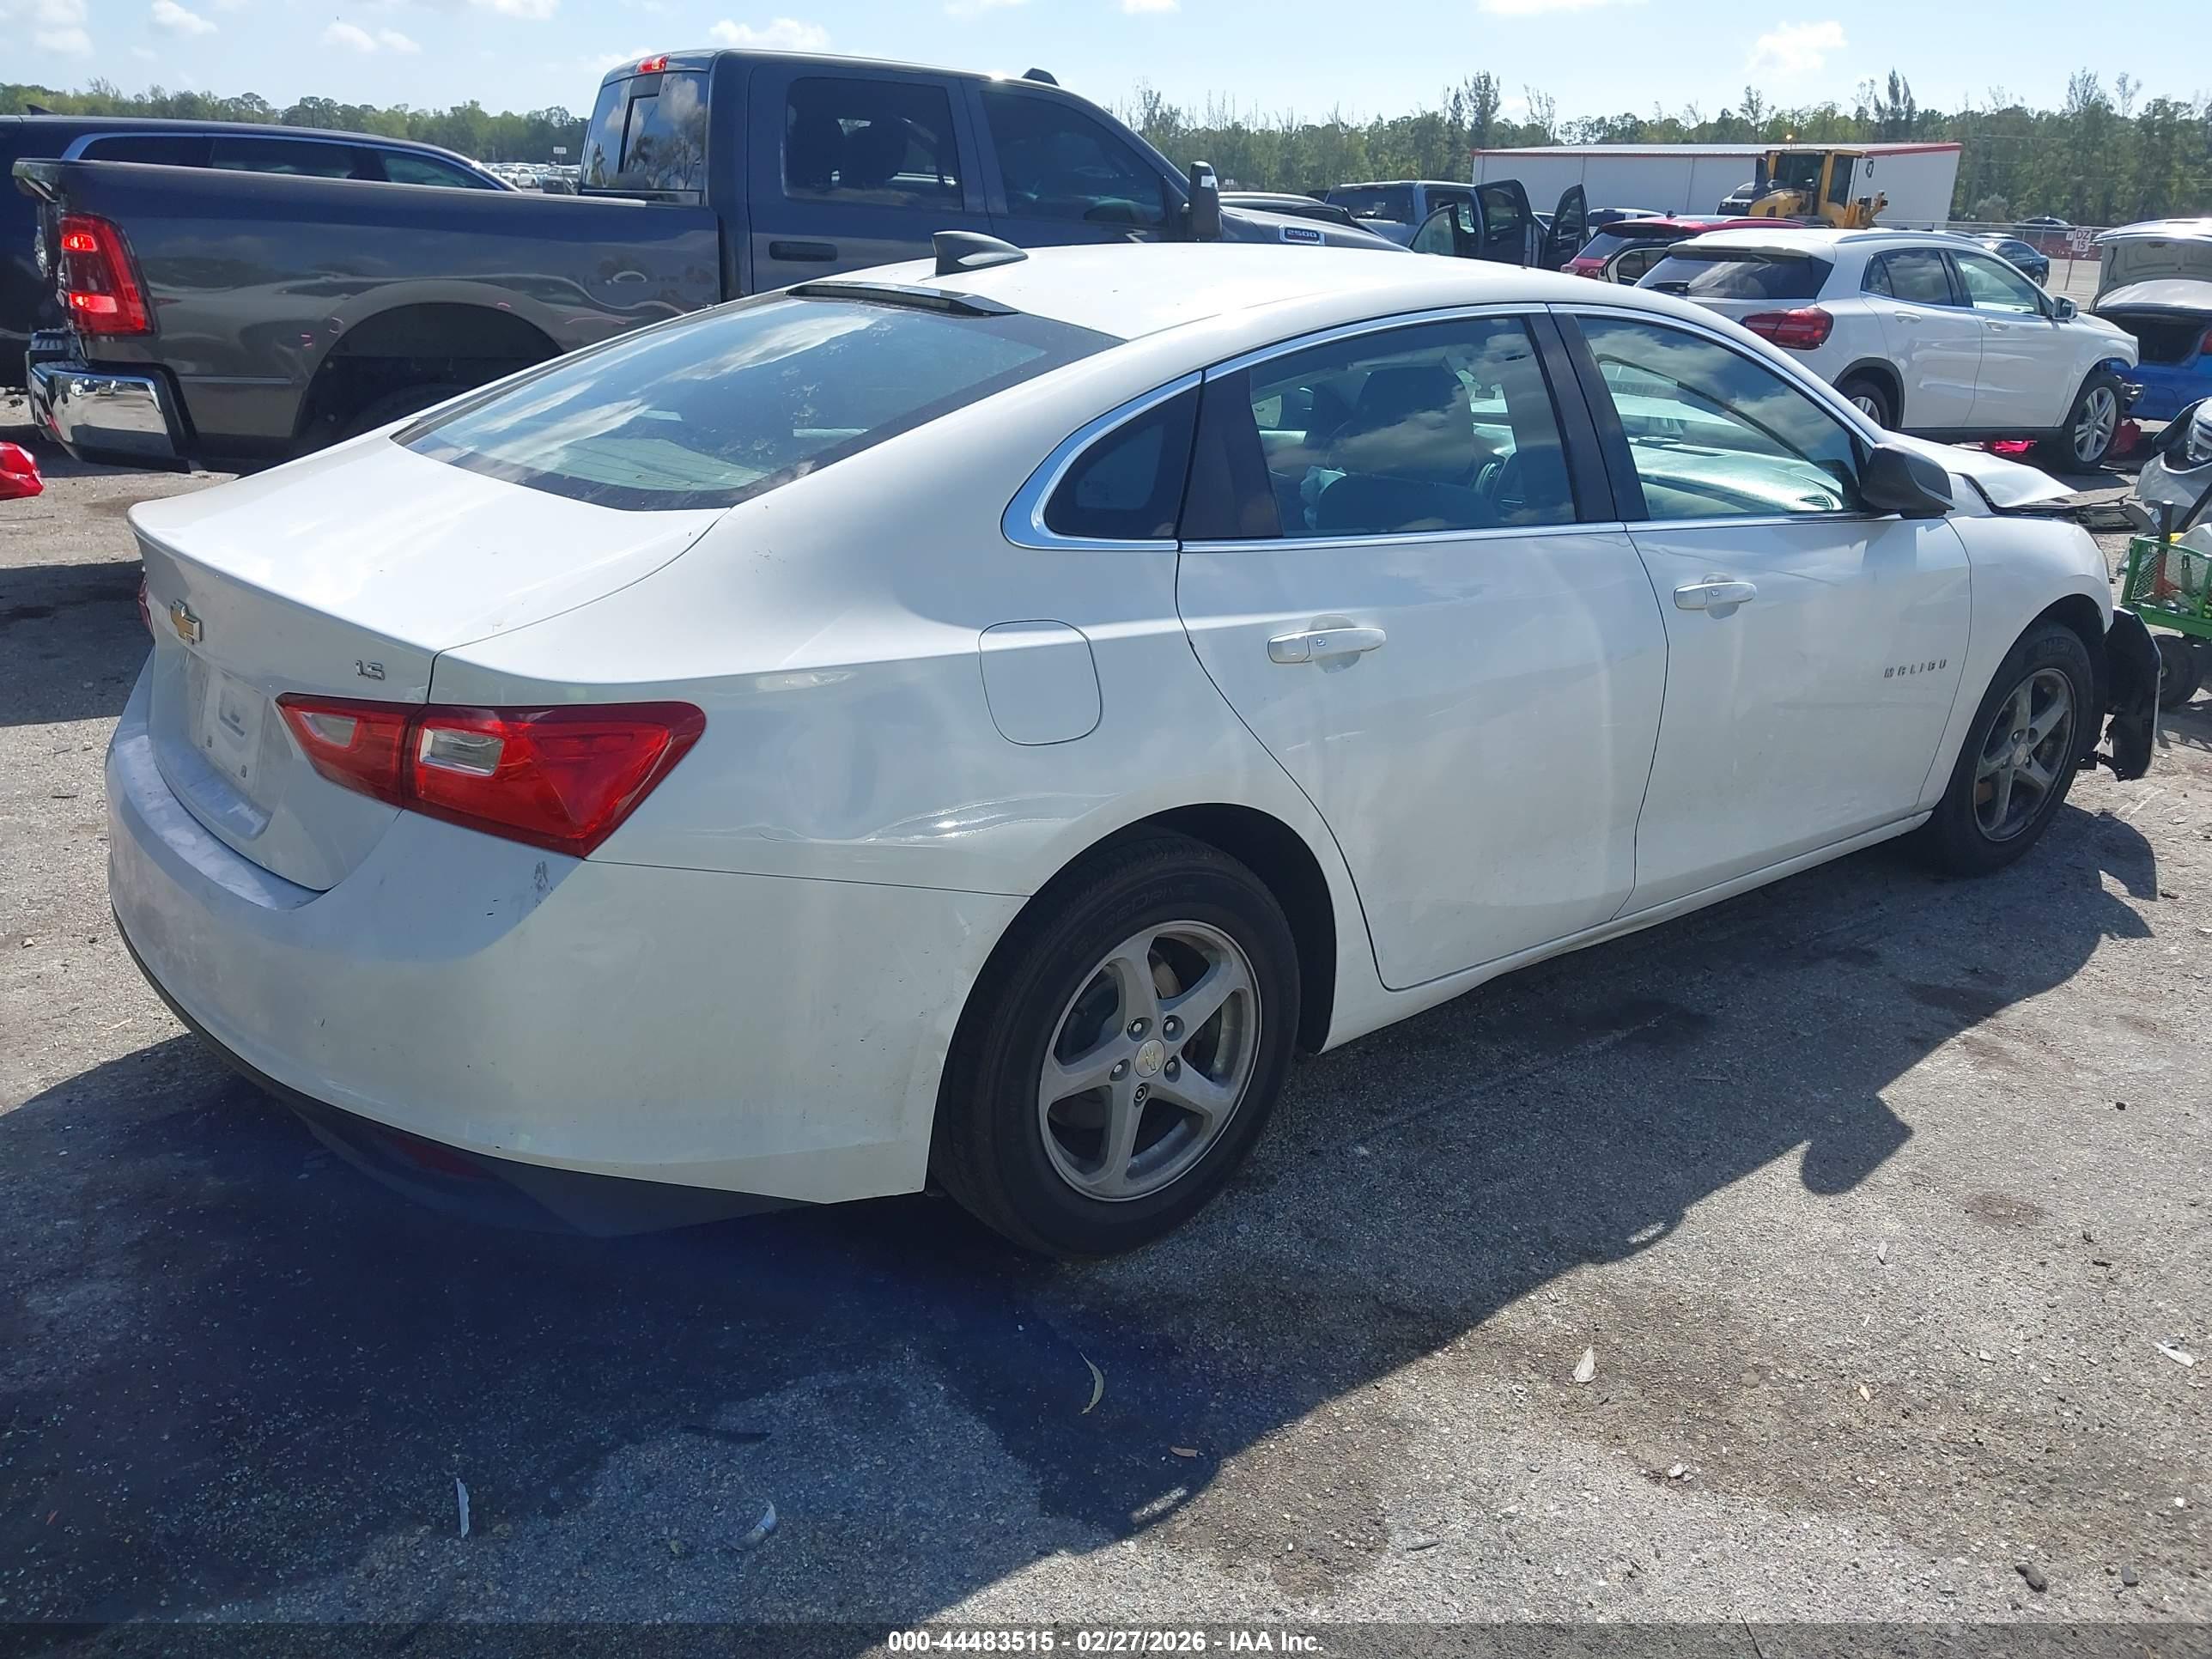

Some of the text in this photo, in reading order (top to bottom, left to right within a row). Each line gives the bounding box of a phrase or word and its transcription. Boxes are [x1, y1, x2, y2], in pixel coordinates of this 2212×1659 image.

[1286, 228, 1317, 238] 2500
[2075, 229, 2090, 240] DZ
[1884, 659, 1947, 678] MALIBU
